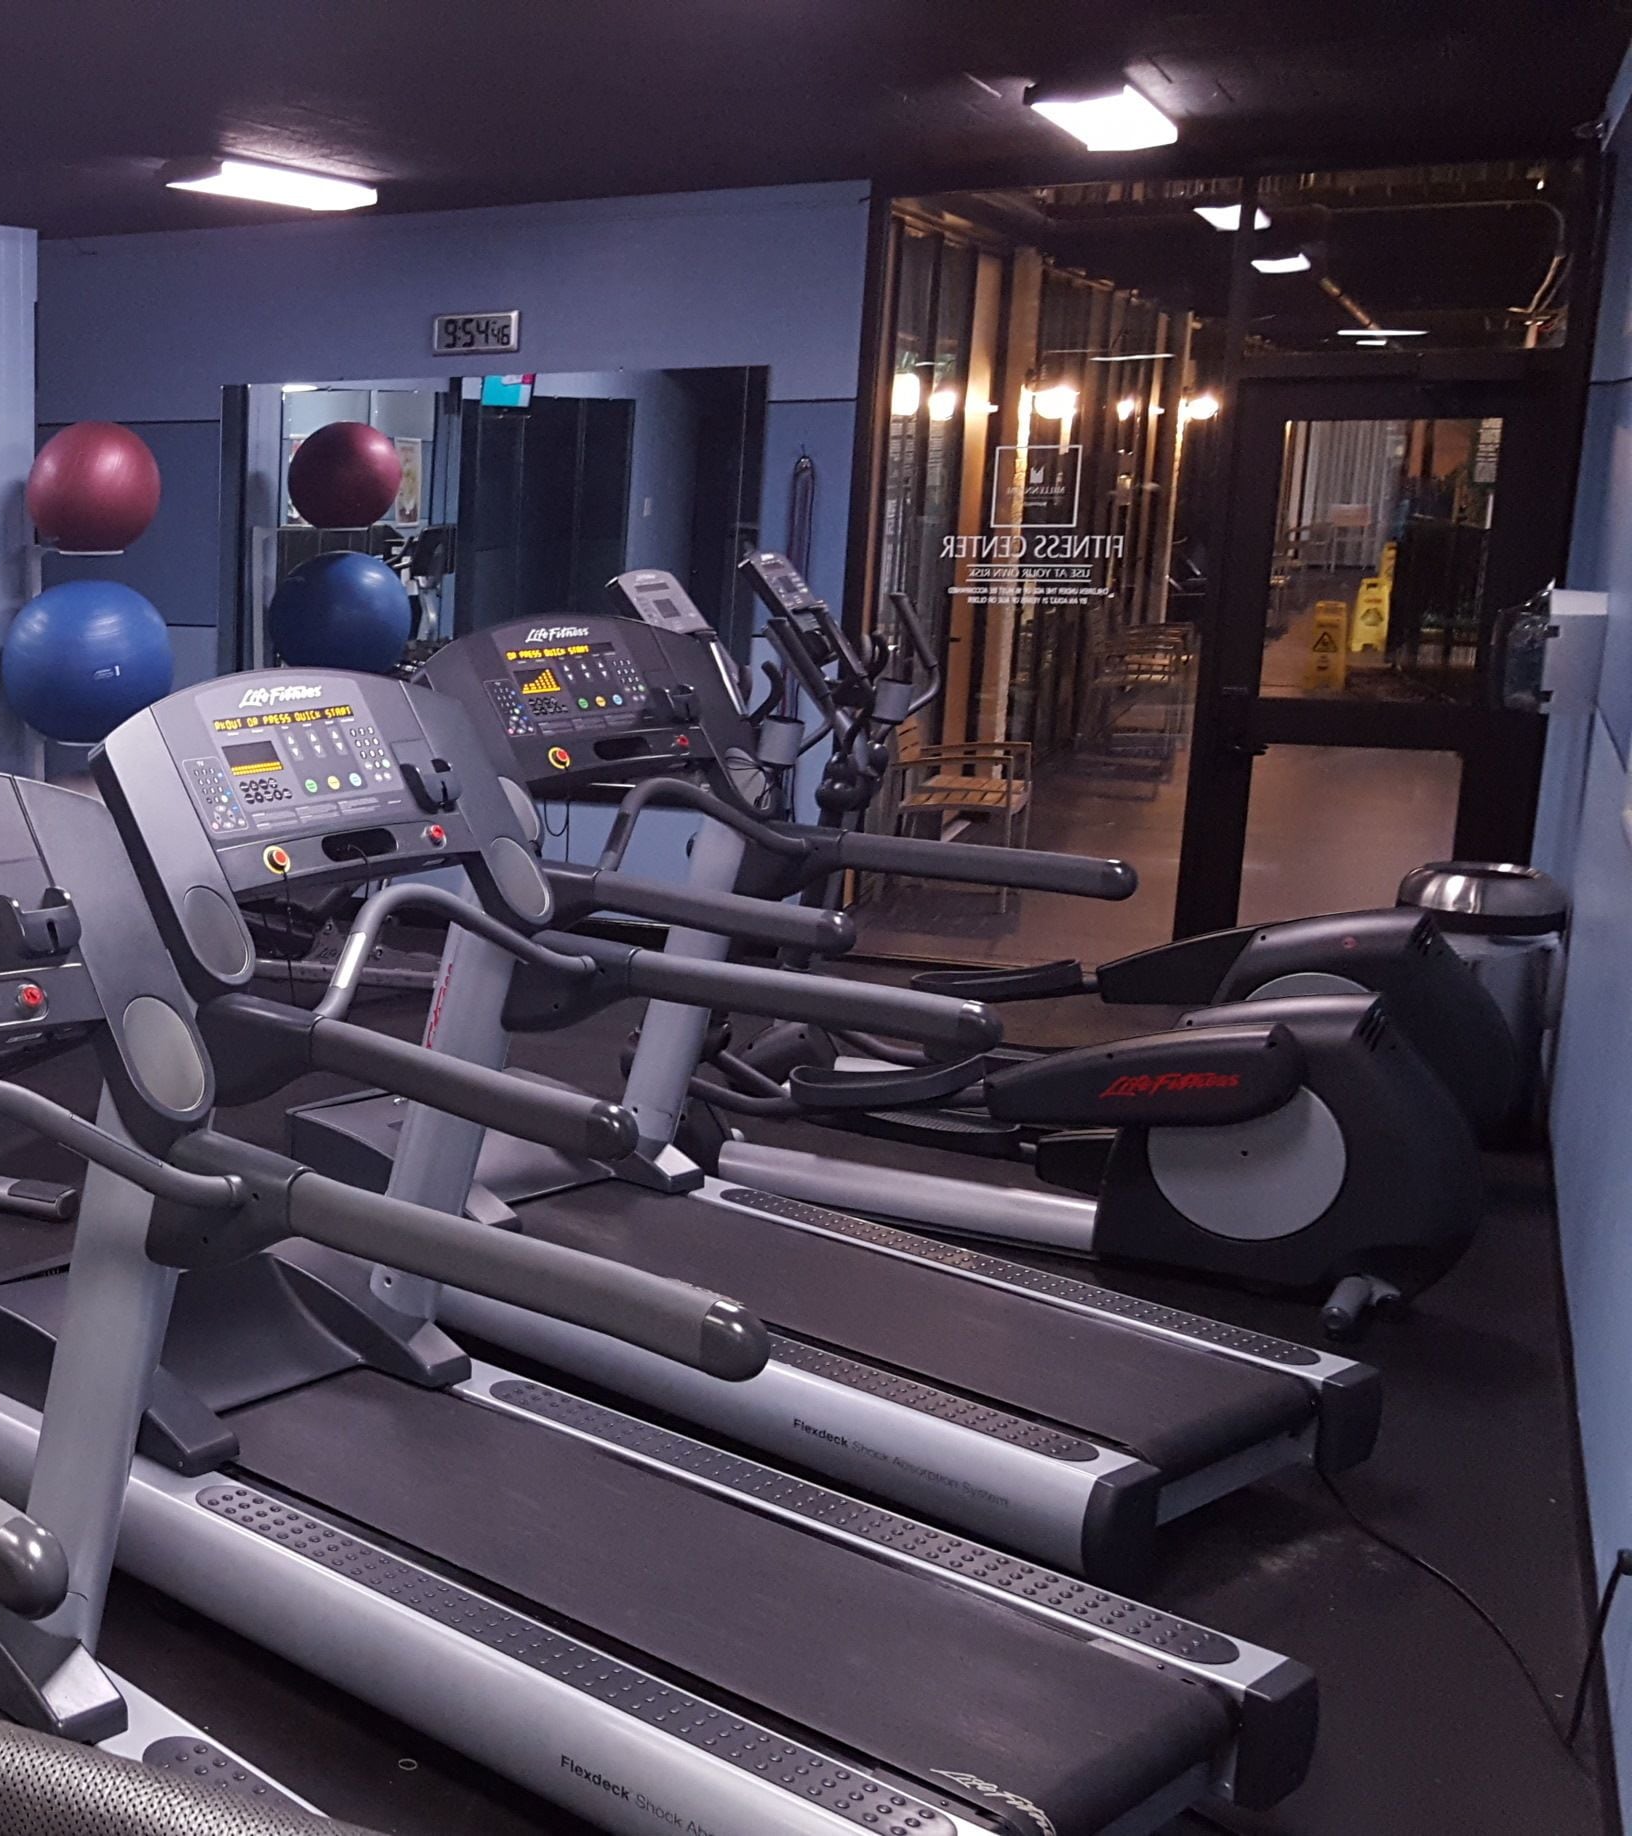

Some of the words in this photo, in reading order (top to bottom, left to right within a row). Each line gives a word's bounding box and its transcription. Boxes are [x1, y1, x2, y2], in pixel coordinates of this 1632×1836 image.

[263, 713, 292, 725] PRESS
[294, 710, 321, 722] QUICK
[325, 706, 352, 719] START
[793, 1418, 848, 1448] Flexdeck
[560, 1754, 630, 1801] Flexdeck
[635, 1793, 683, 1828] Shock
